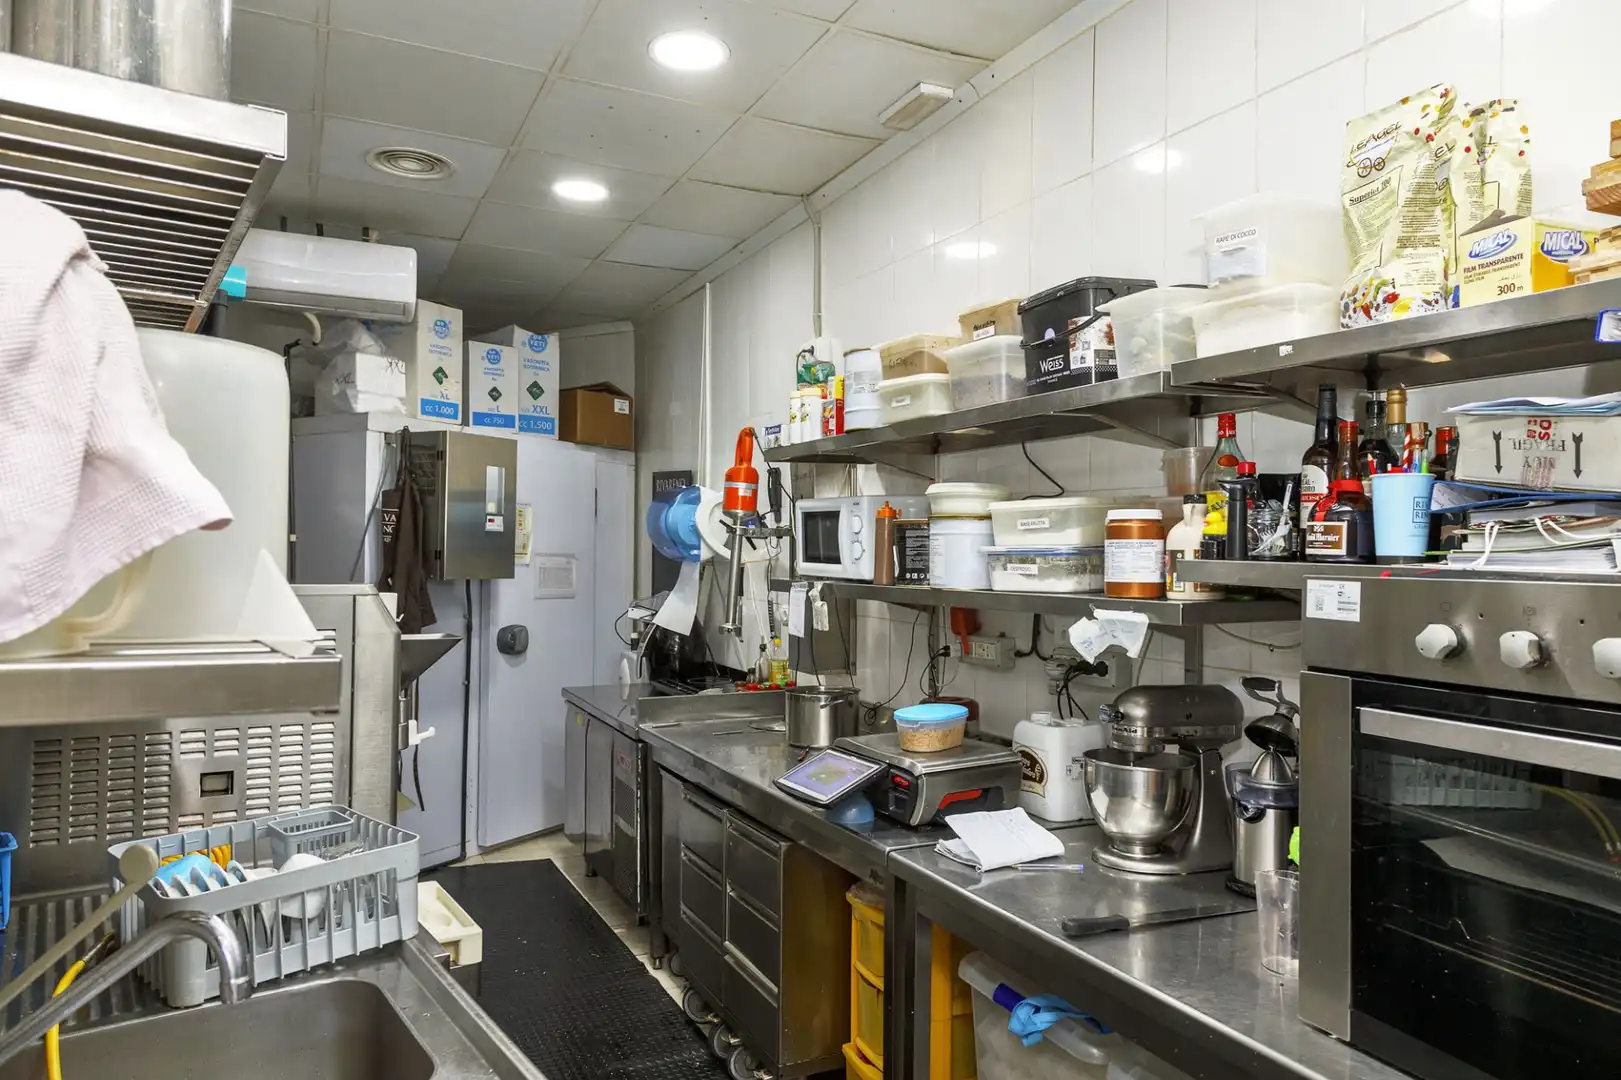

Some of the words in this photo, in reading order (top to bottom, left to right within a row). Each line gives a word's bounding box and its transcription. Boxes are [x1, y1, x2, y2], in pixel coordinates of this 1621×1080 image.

[1237, 228, 1257, 239] COCCO
[1471, 228, 1512, 256] MICAL
[1543, 230, 1583, 252] MICAL
[1463, 265, 1477, 274] FILM
[1478, 252, 1524, 270] TRANSPARENTE
[1497, 282, 1516, 296] 300
[439, 391, 450, 400] XL
[435, 404, 454, 415] 1.000
[496, 405, 501, 413] L
[532, 405, 550, 415] XXL
[492, 417, 505, 425] 750
[530, 420, 552, 430] 1.500
[383, 513, 397, 522] VA
